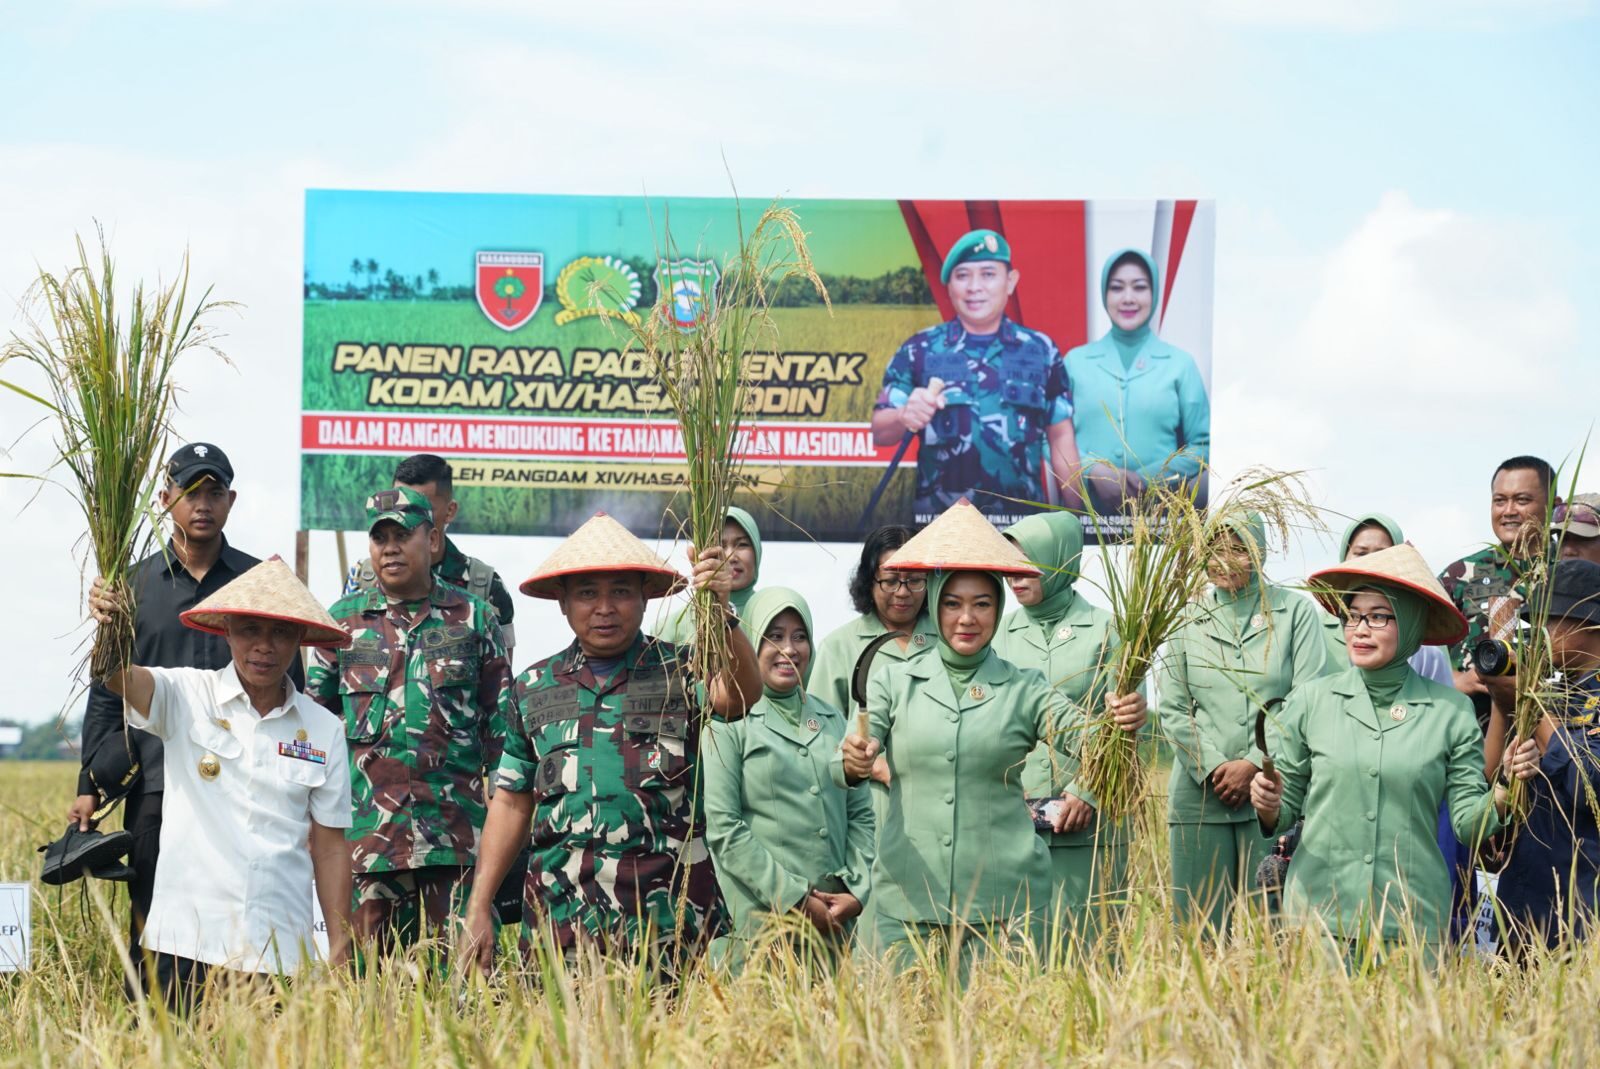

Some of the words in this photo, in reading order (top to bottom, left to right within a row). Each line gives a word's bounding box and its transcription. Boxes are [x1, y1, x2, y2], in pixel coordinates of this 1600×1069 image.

[333, 343, 465, 374] PANEN
[467, 347, 565, 377] RAYA
[571, 350, 658, 379] PADI
[368, 377, 505, 406] KODAM
[318, 419, 384, 446] DALAM
[387, 421, 464, 448] RANGKA
[467, 423, 584, 451] MENDUKUNG
[587, 426, 694, 453] KETAHANA
[783, 431, 878, 456] NASIONAL
[491, 468, 588, 483] PANGDAM
[0, 925, 18, 936] EP
